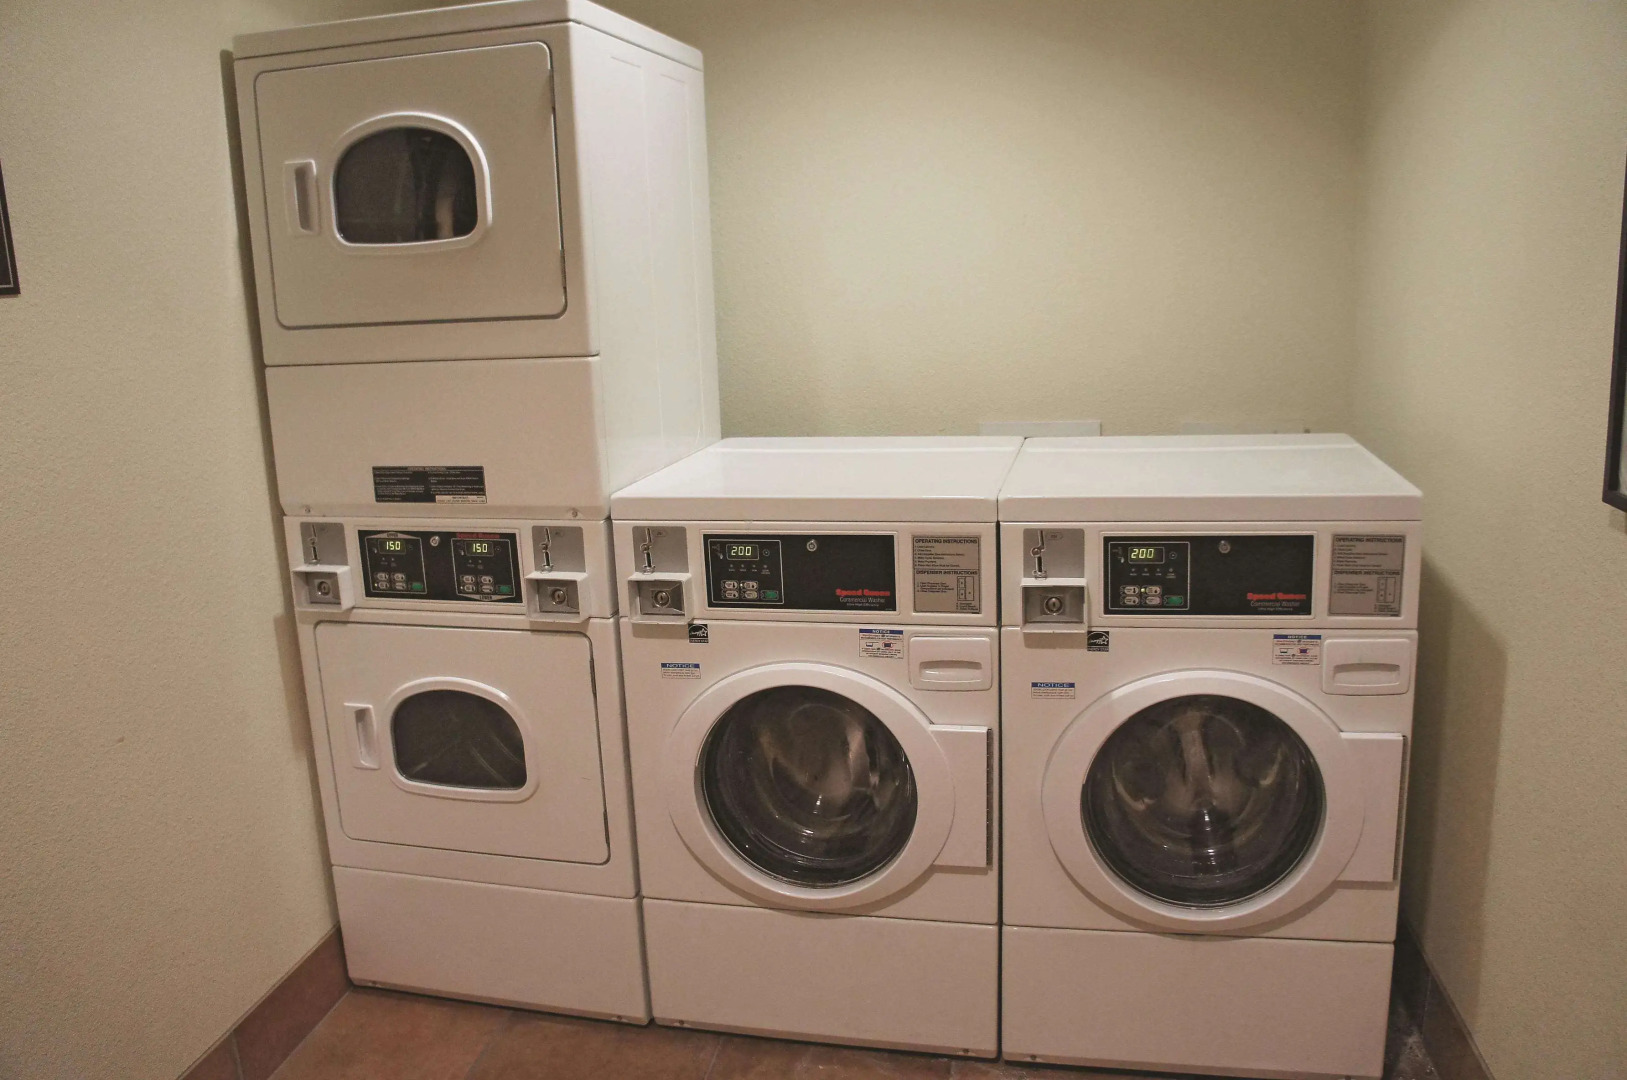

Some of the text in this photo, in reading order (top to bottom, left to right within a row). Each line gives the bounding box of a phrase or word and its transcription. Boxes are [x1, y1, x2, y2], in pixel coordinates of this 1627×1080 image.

[386, 541, 401, 551] 150
[472, 543, 488, 553] 150
[731, 546, 752, 556] 200
[1131, 548, 1155, 559] 200
[835, 588, 891, 597] Speed Queen
[1246, 592, 1307, 601] Speed Queen
